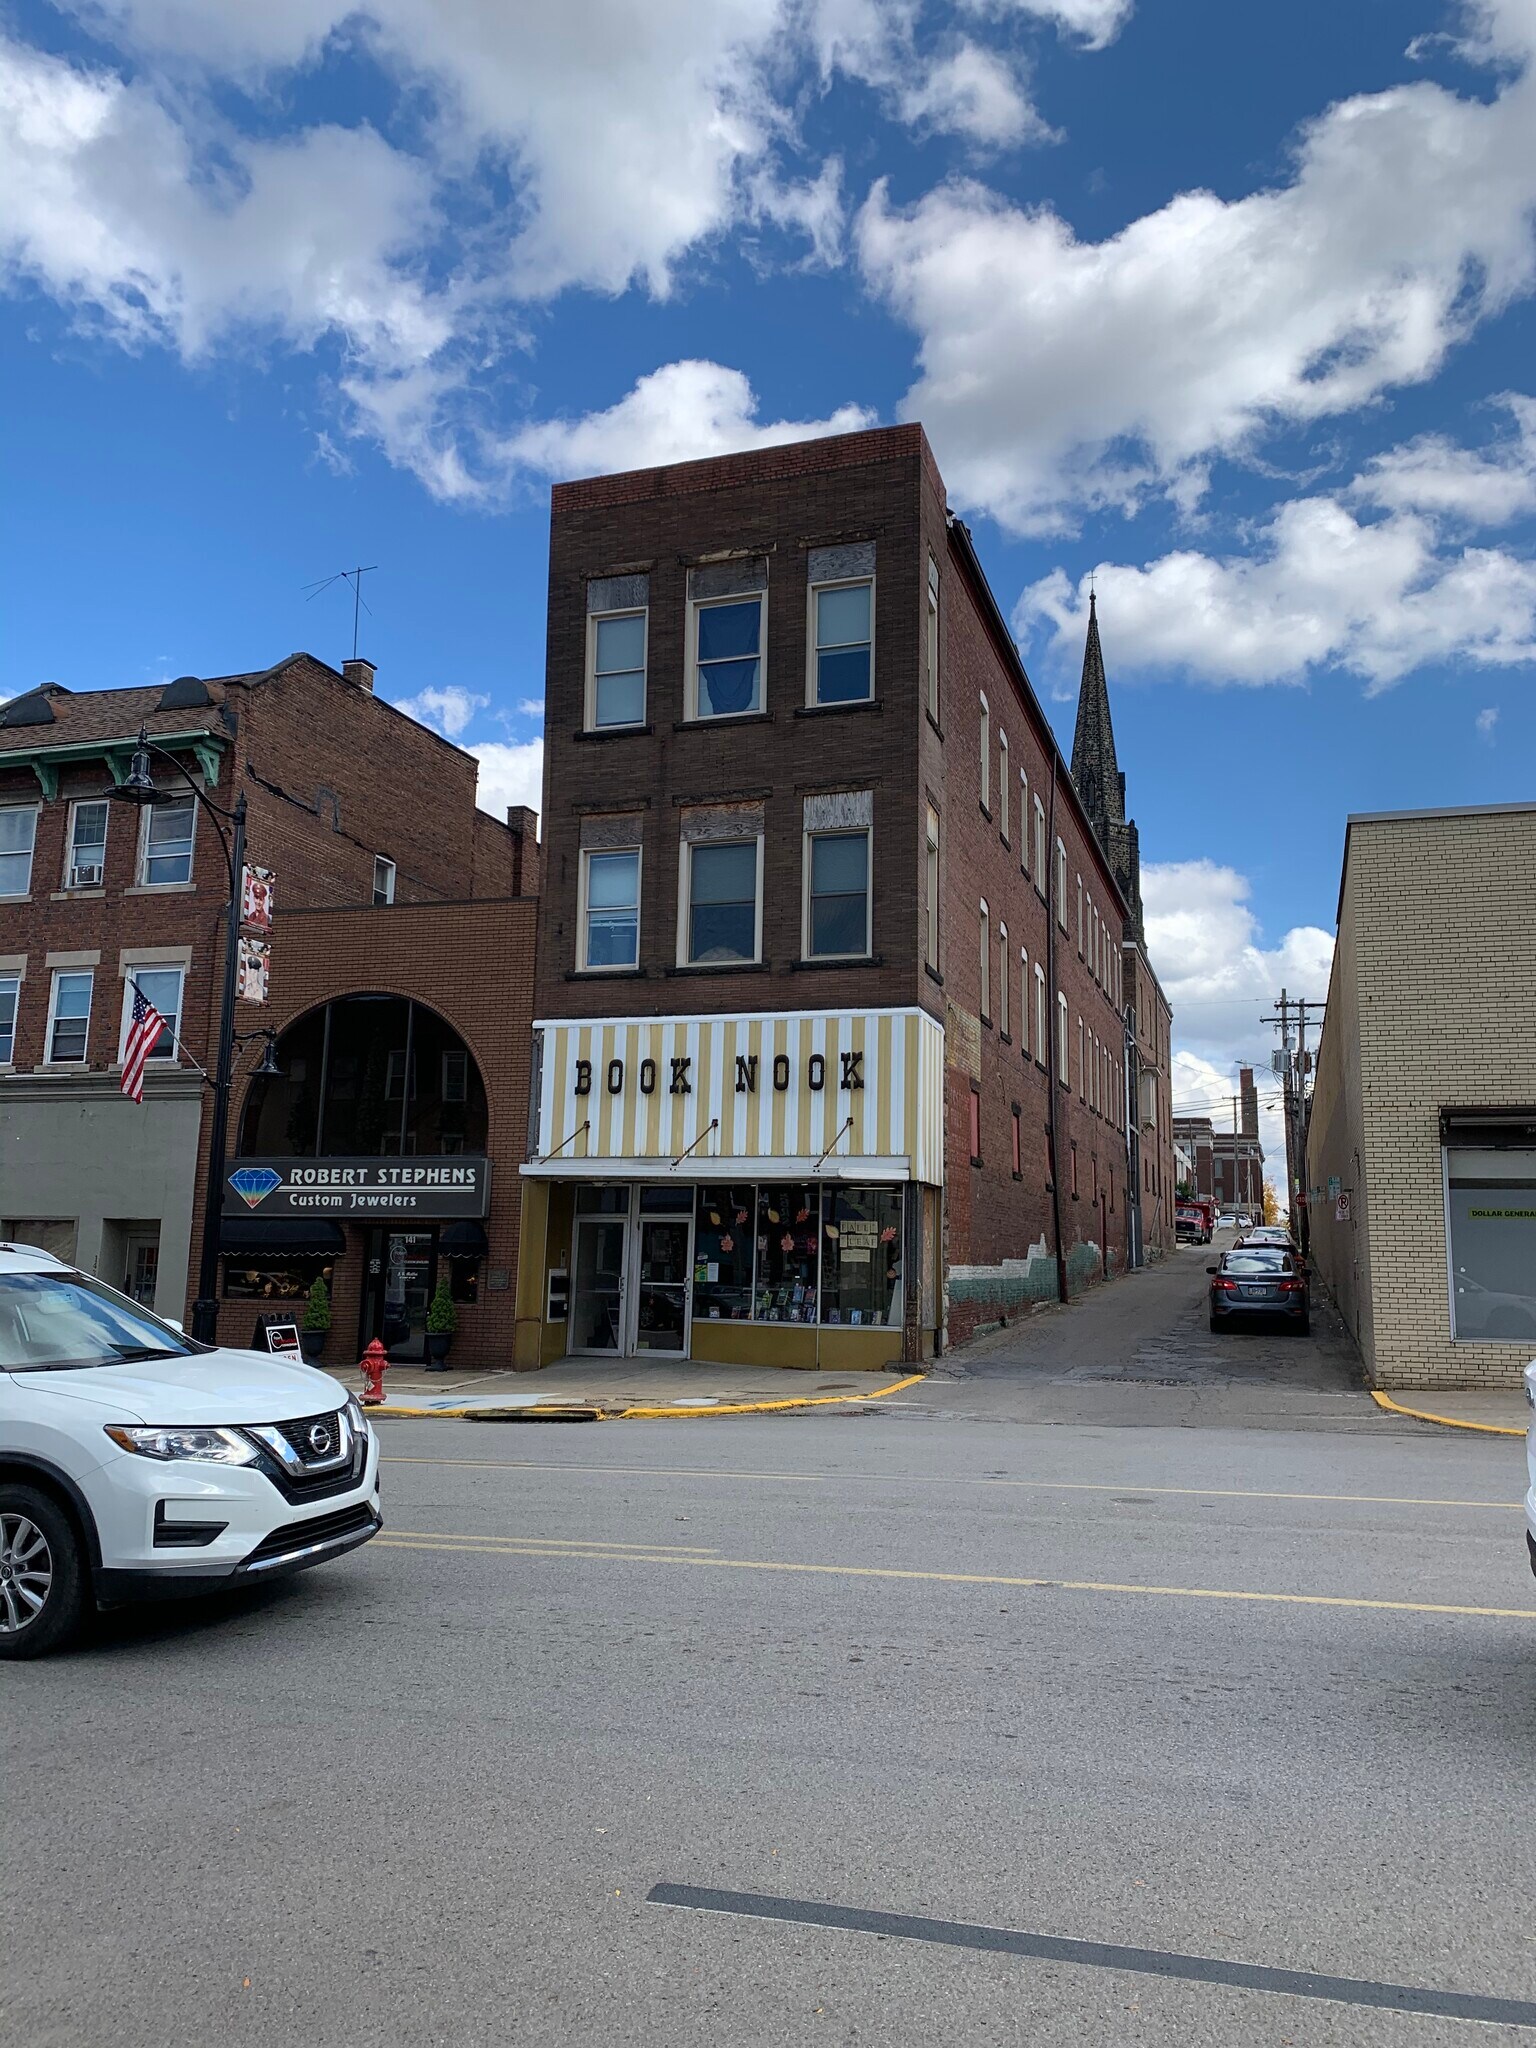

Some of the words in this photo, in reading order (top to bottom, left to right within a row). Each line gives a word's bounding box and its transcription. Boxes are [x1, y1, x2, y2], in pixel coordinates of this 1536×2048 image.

[574, 1057, 692, 1096] BOOK
[736, 1051, 865, 1093] NOOK
[289, 1168, 369, 1185] ROBERT
[377, 1168, 477, 1185] STEPHENS
[289, 1193, 343, 1206] Custom
[349, 1192, 417, 1209] Jewelers
[405, 1236, 417, 1244] 141
